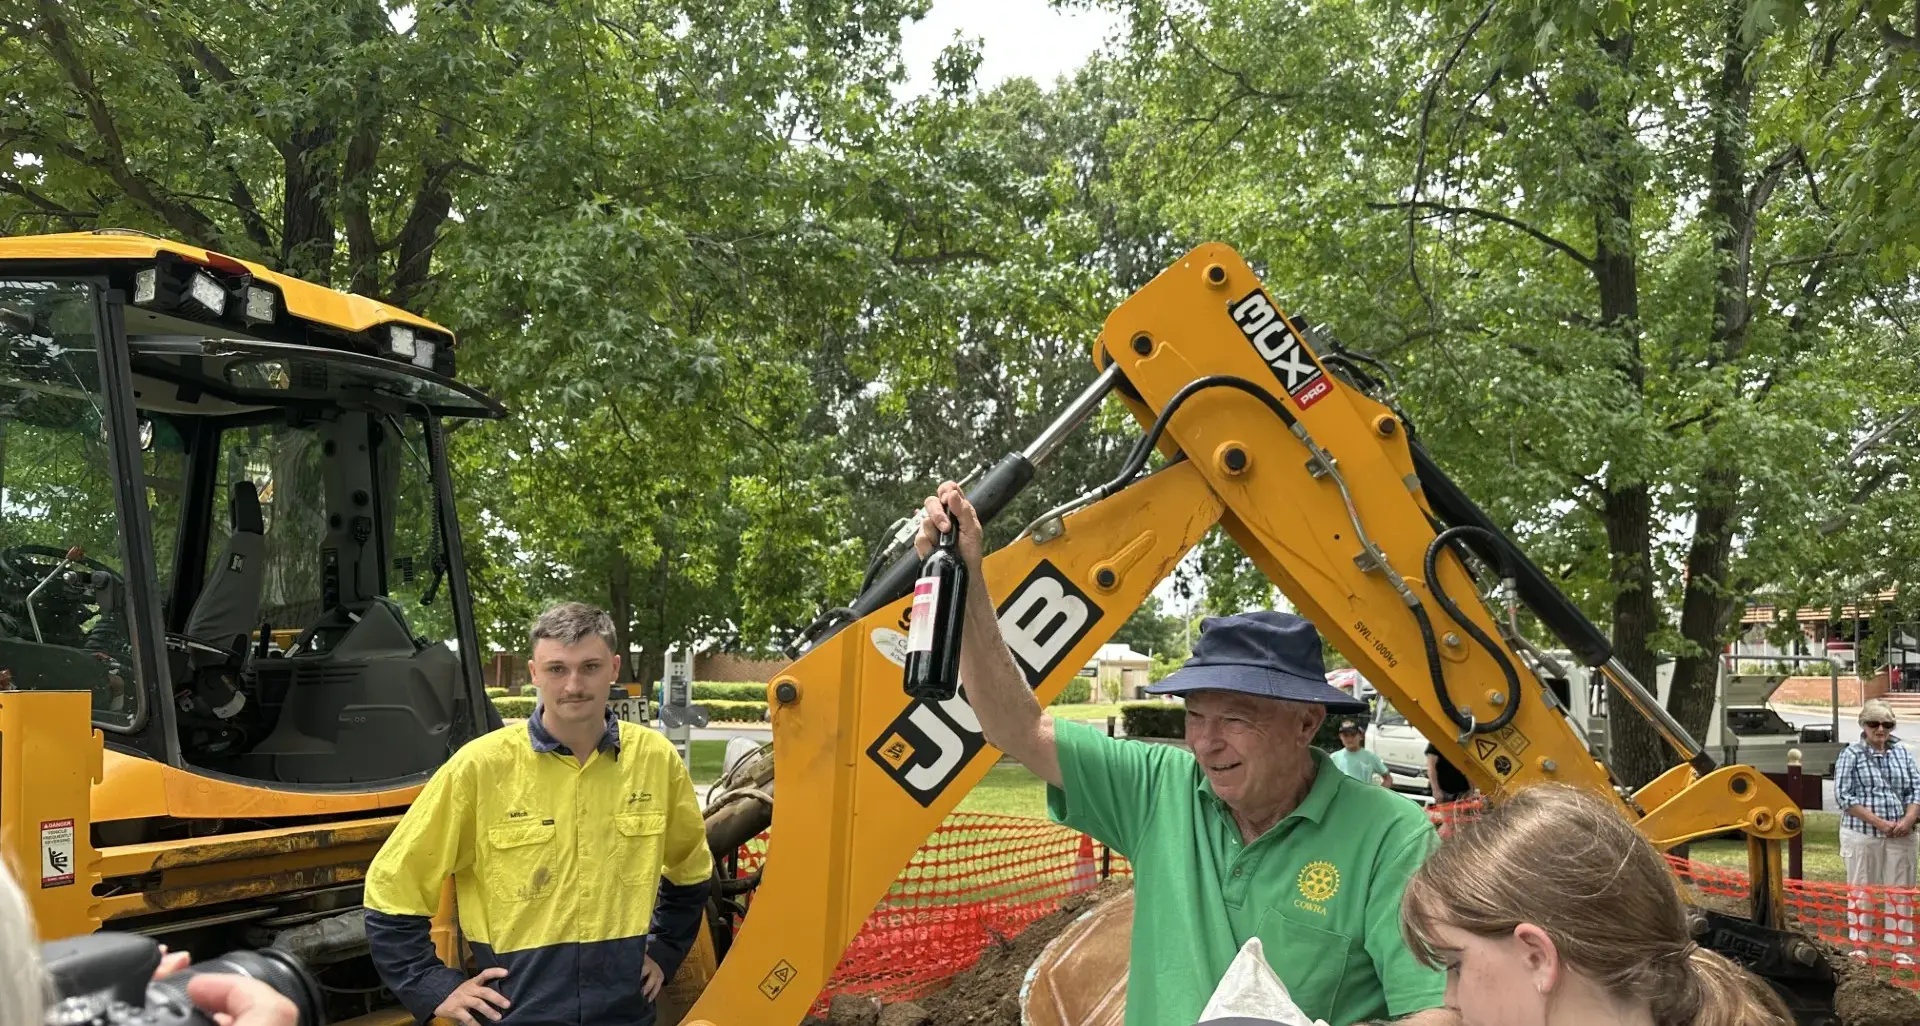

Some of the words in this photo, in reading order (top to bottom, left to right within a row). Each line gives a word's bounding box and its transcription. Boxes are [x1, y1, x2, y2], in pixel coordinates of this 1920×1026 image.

[1233, 293, 1318, 390] 3CX
[1300, 382, 1327, 405] PRO
[1354, 620, 1398, 668] SWL:1000kg
[48, 820, 71, 828] DANGER
[1293, 899, 1327, 916] COWRA
